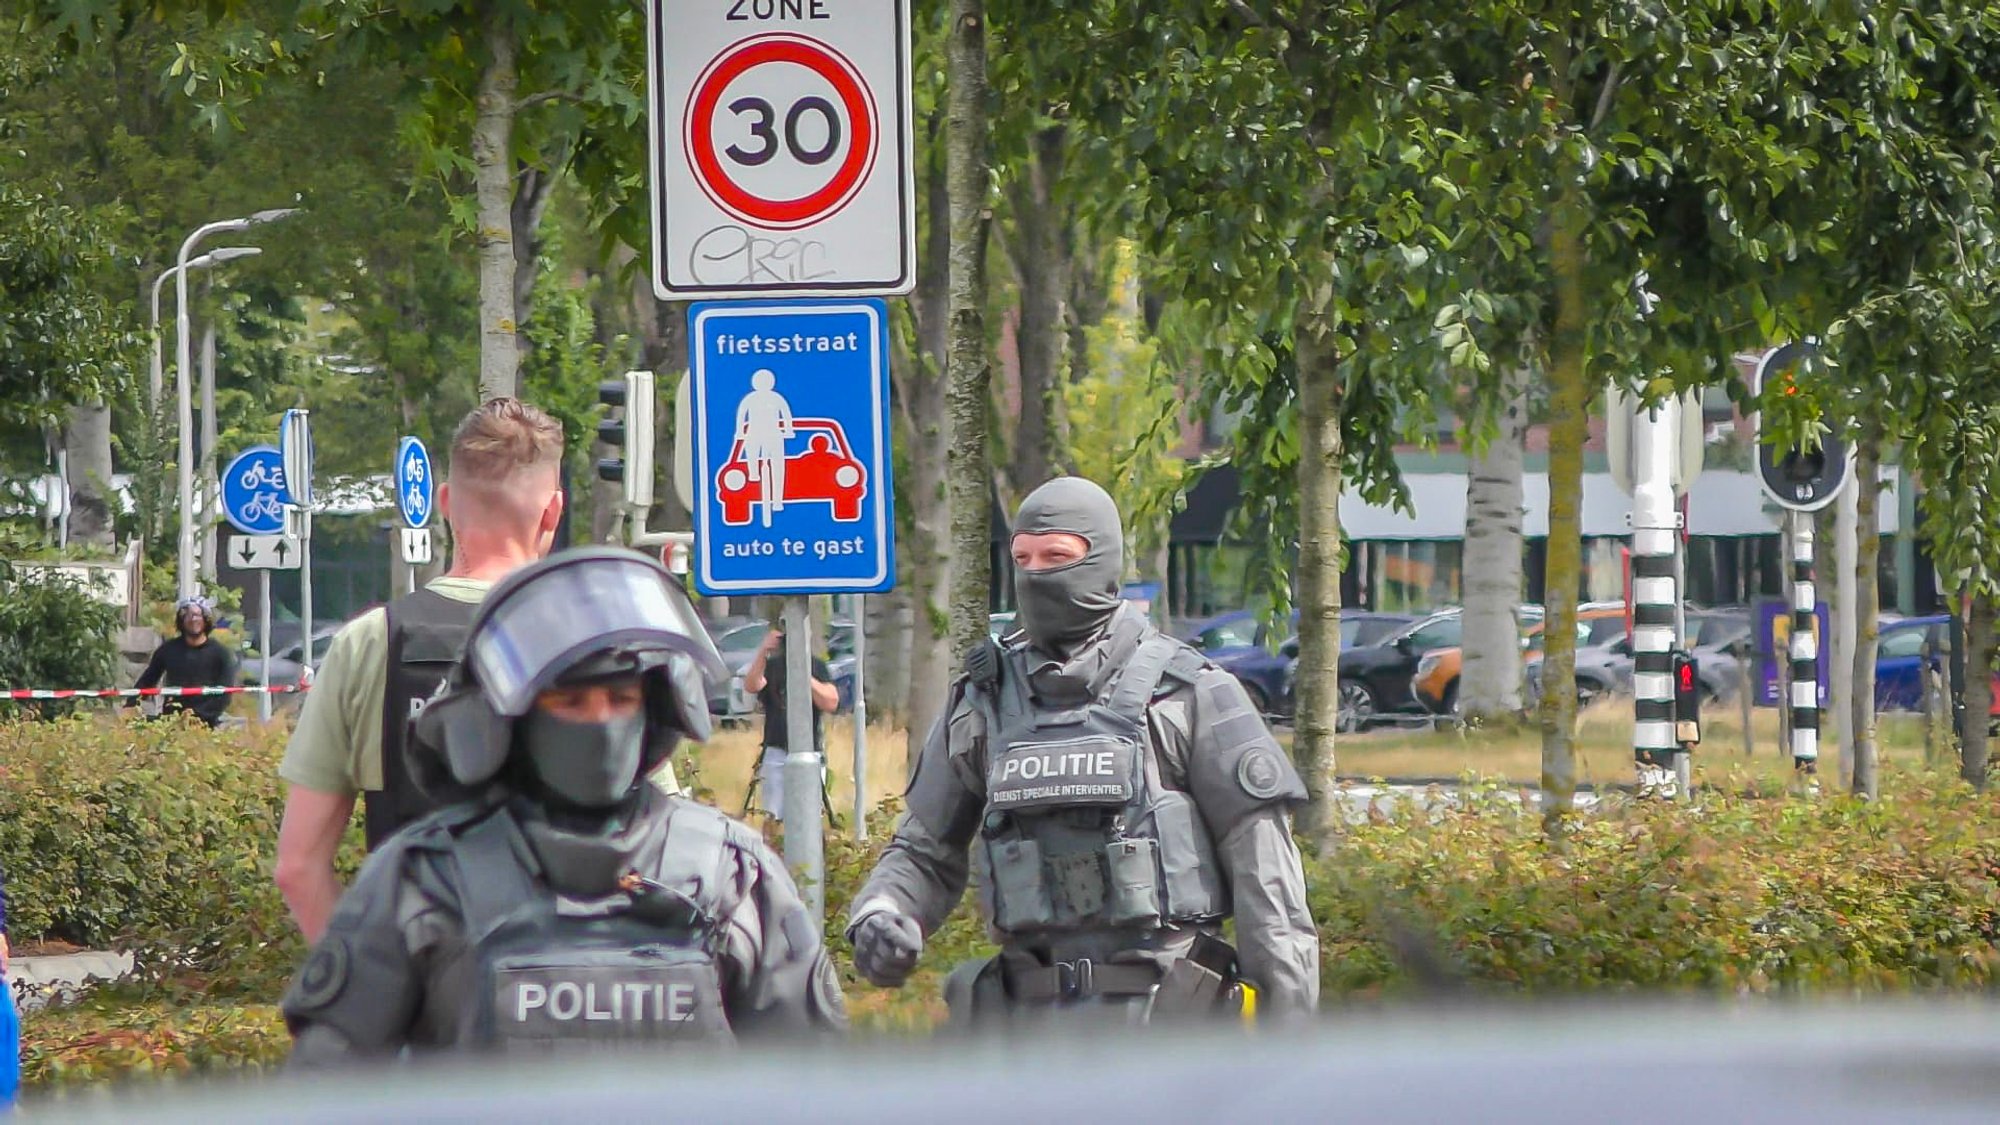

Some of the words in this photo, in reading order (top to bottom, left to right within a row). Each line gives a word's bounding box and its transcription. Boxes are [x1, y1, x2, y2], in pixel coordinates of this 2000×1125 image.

[726, 0, 830, 20] ZONE
[724, 96, 842, 167] 30
[716, 332, 858, 355] fietsstraat
[722, 538, 774, 557] auto
[782, 537, 806, 556] te
[813, 536, 865, 560] gast
[1002, 752, 1114, 781] POLITIE
[1061, 784, 1122, 796] INTERVENTIES
[516, 981, 696, 1022] POLITIE
